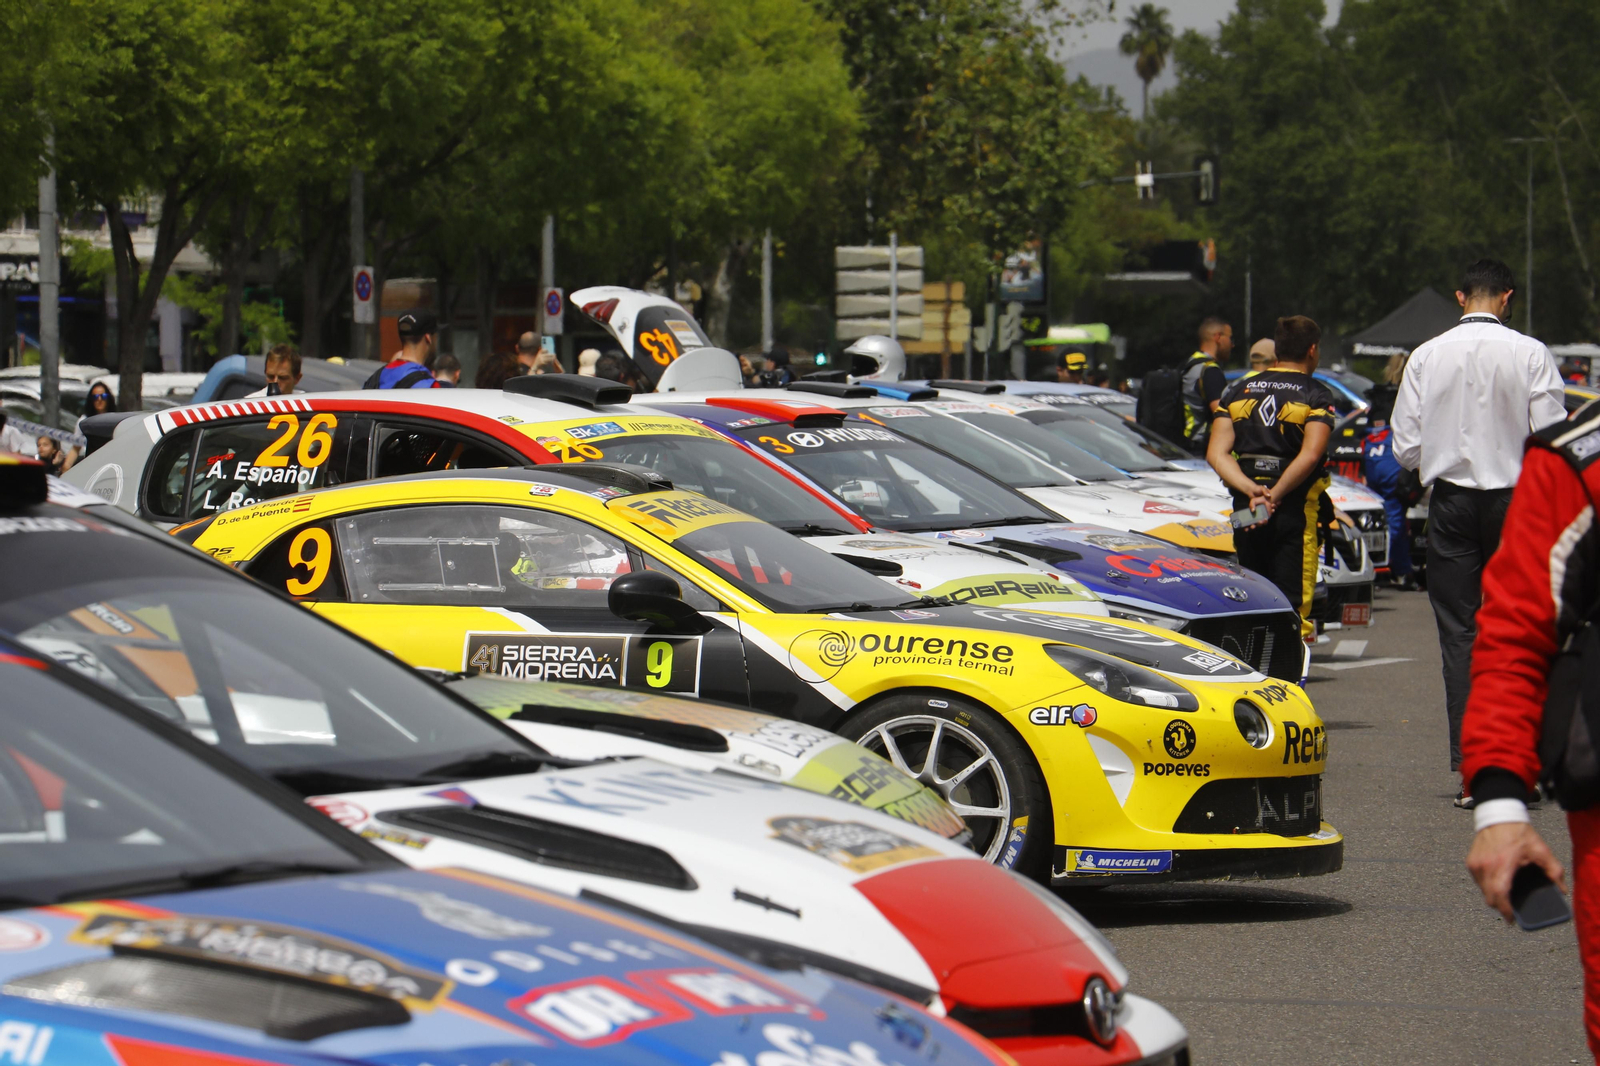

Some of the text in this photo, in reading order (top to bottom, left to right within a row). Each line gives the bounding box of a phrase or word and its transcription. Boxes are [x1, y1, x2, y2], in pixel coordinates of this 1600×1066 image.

[254, 413, 338, 468] 26
[542, 438, 604, 463] 26
[758, 435, 795, 454] 3
[206, 460, 318, 487] A. Español
[202, 489, 221, 510] L.
[217, 518, 229, 526] D.
[229, 516, 241, 524] de
[251, 506, 291, 519] Puente
[286, 527, 332, 596] 9
[859, 632, 1014, 663] ourense
[501, 662, 616, 681] MORENA
[502, 645, 595, 662] SIERRA
[645, 641, 674, 688] 9
[873, 653, 1014, 677] provincia termal
[1030, 706, 1071, 725] elf
[1167, 721, 1192, 733] LOUISIANA
[1168, 747, 1190, 757] KITCHEN
[1097, 857, 1161, 868] MICHELIN
